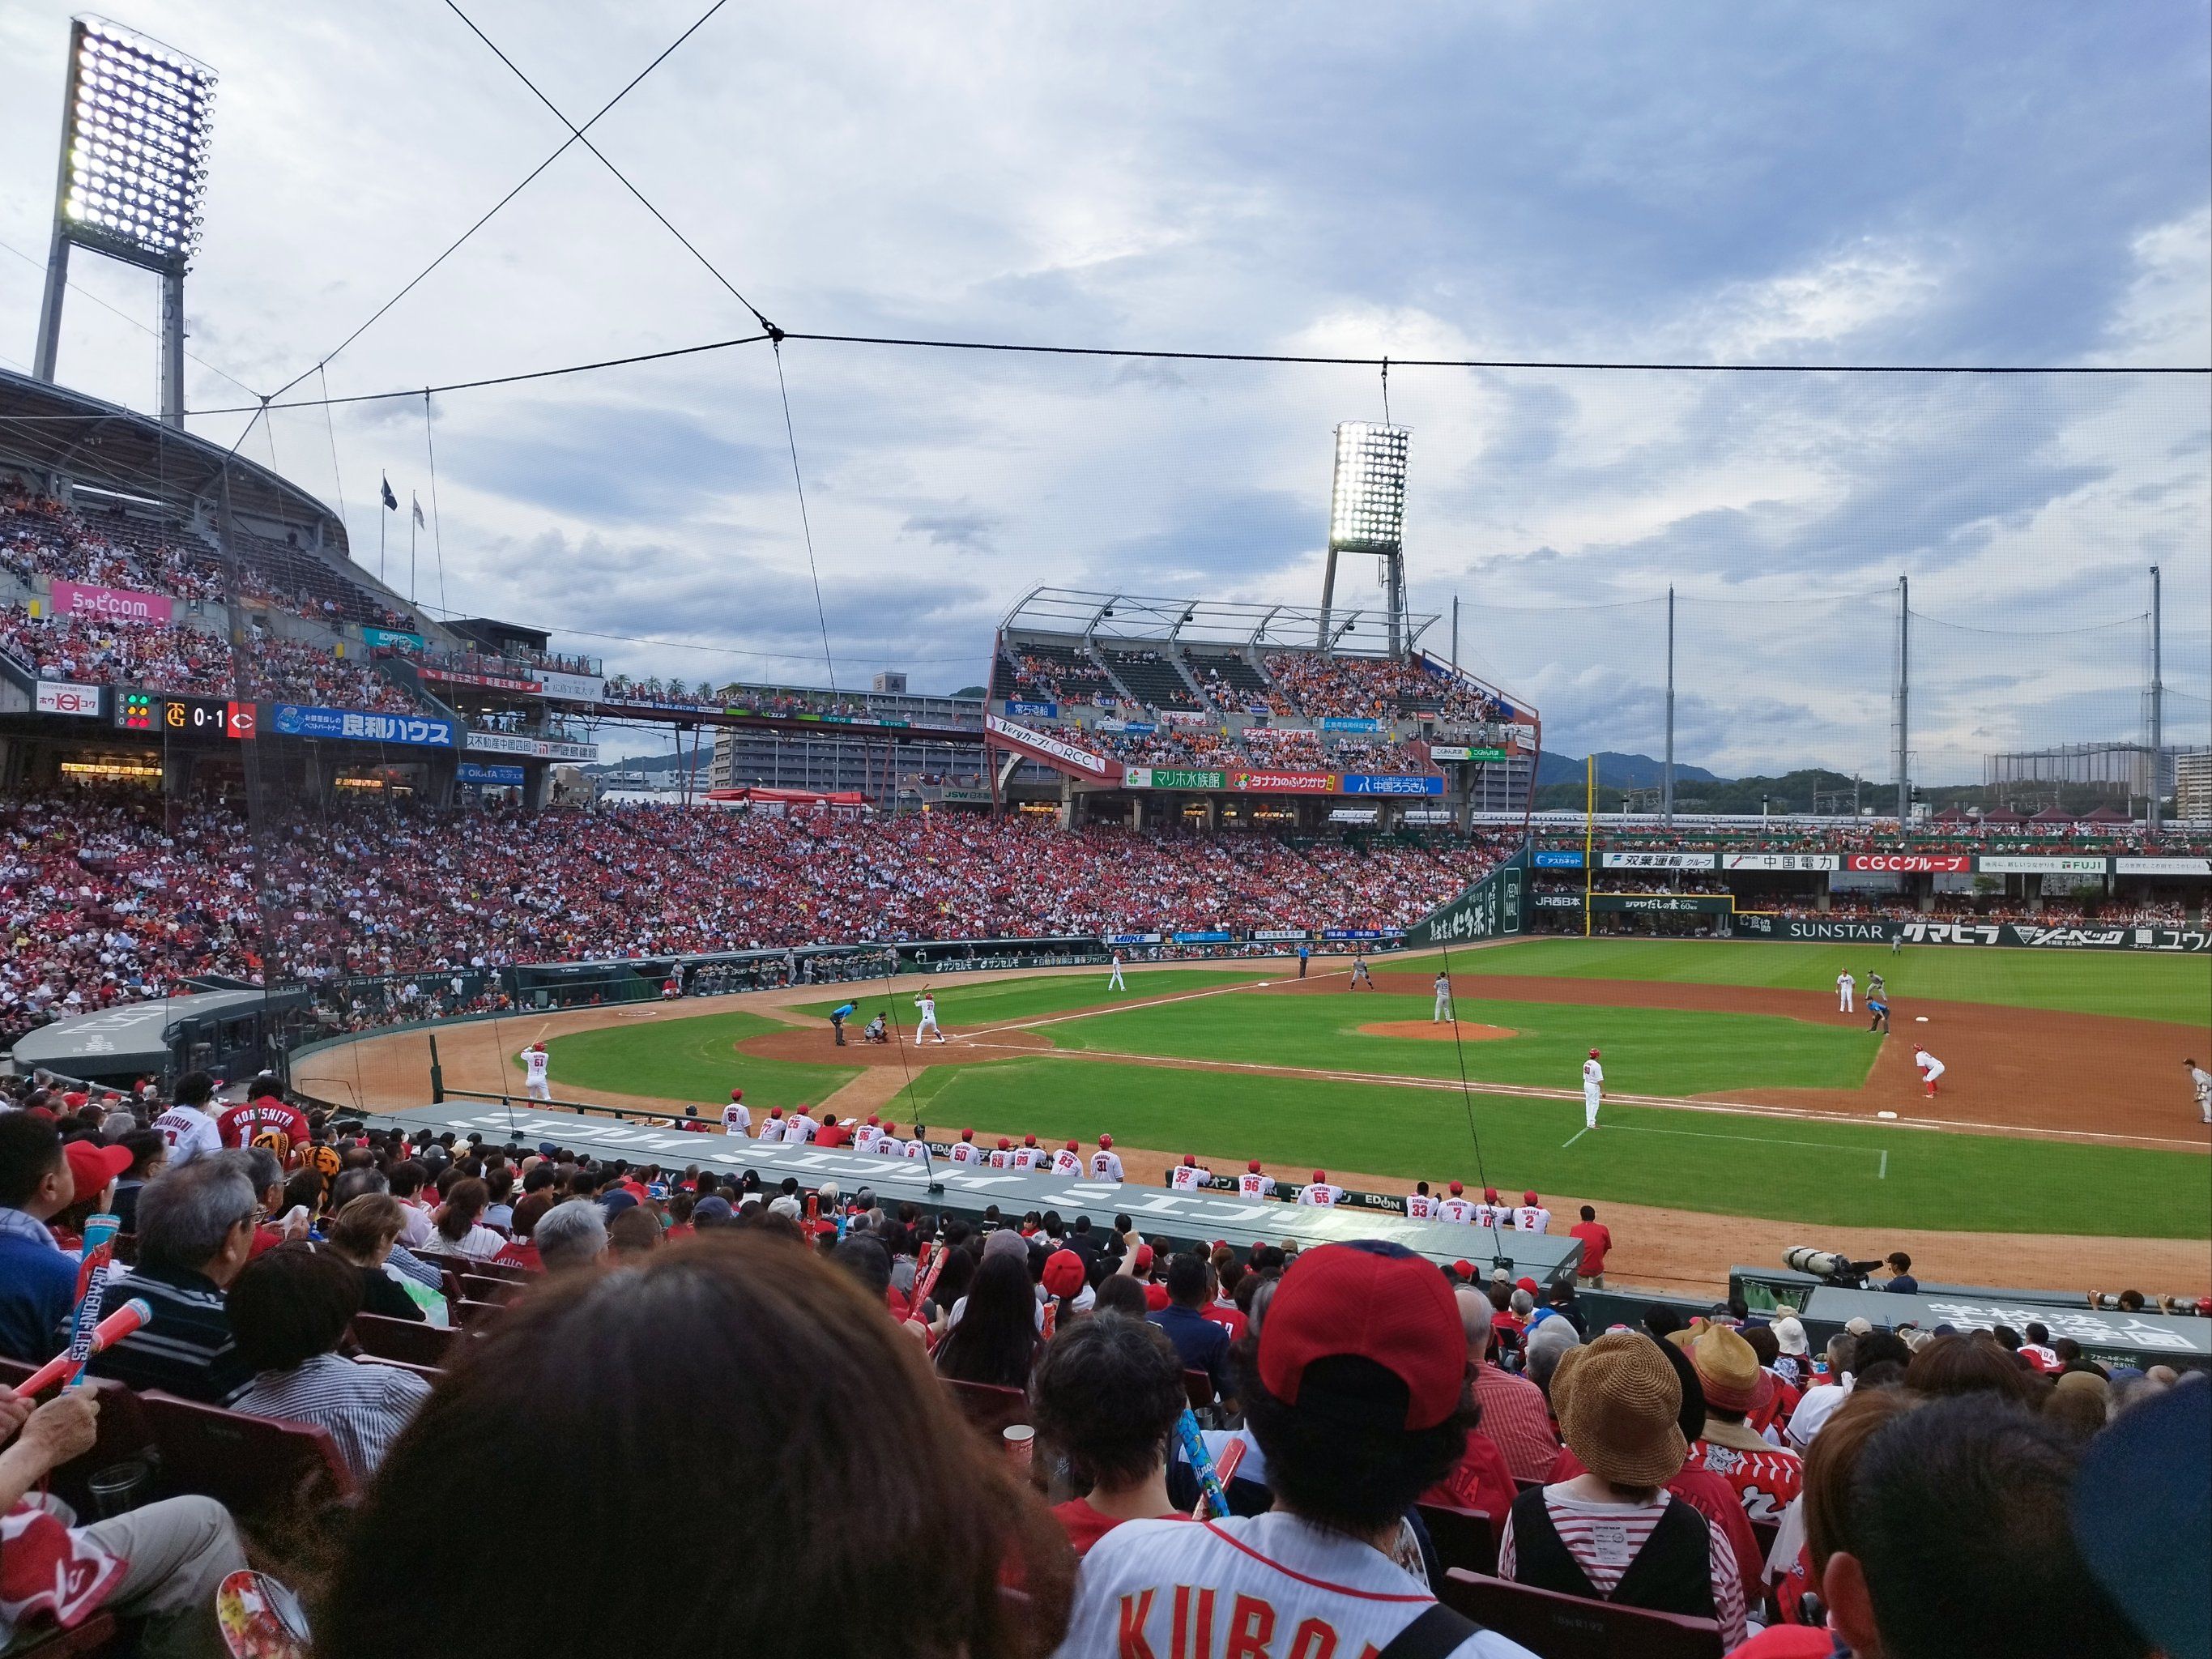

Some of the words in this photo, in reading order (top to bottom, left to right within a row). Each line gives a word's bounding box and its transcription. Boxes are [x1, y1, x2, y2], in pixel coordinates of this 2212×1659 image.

[39, 697, 55, 705] ホウ
[81, 700, 96, 709] コク
[1015, 704, 1049, 716] 常石造船
[342, 714, 450, 744] 良利ハウス
[1063, 748, 1092, 766] RCC
[1157, 771, 1221, 788] マリホ水族館
[1251, 775, 1327, 788] タナカのふりかけ
[1373, 781, 1429, 793] 中国ろうきん
[1625, 855, 1682, 867] 双葉運輸
[1686, 859, 1712, 867] グループ
[1764, 855, 1832, 869] 中国電力
[1856, 856, 1963, 872] CGCグループ
[2073, 861, 2101, 869] FUJI
[1536, 897, 1580, 906] JR西日本
[1750, 915, 1771, 932] 食協
[1790, 923, 1884, 939] SUNSTAR
[1903, 924, 2000, 944] クマヒラ
[2031, 928, 2125, 945] ジーベック
[1114, 935, 1146, 943] MIIKE
[943, 962, 972, 970] サンセルモ
[987, 959, 1019, 968] サンセルモ
[1074, 956, 1108, 965] 損保ジャパン
[535, 1059, 543, 1067] 61
[788, 1120, 800, 1128] 25
[908, 1148, 915, 1158] 9
[1059, 1156, 1073, 1168] 83
[1097, 1161, 1106, 1172] 31
[1176, 1172, 1190, 1183] 32
[1244, 1180, 1259, 1192] 96
[1412, 1204, 1428, 1217] 33
[1454, 1208, 1462, 1220] 7
[1525, 1216, 1534, 1229] 2
[1928, 1303, 2175, 1333] 学校法人
